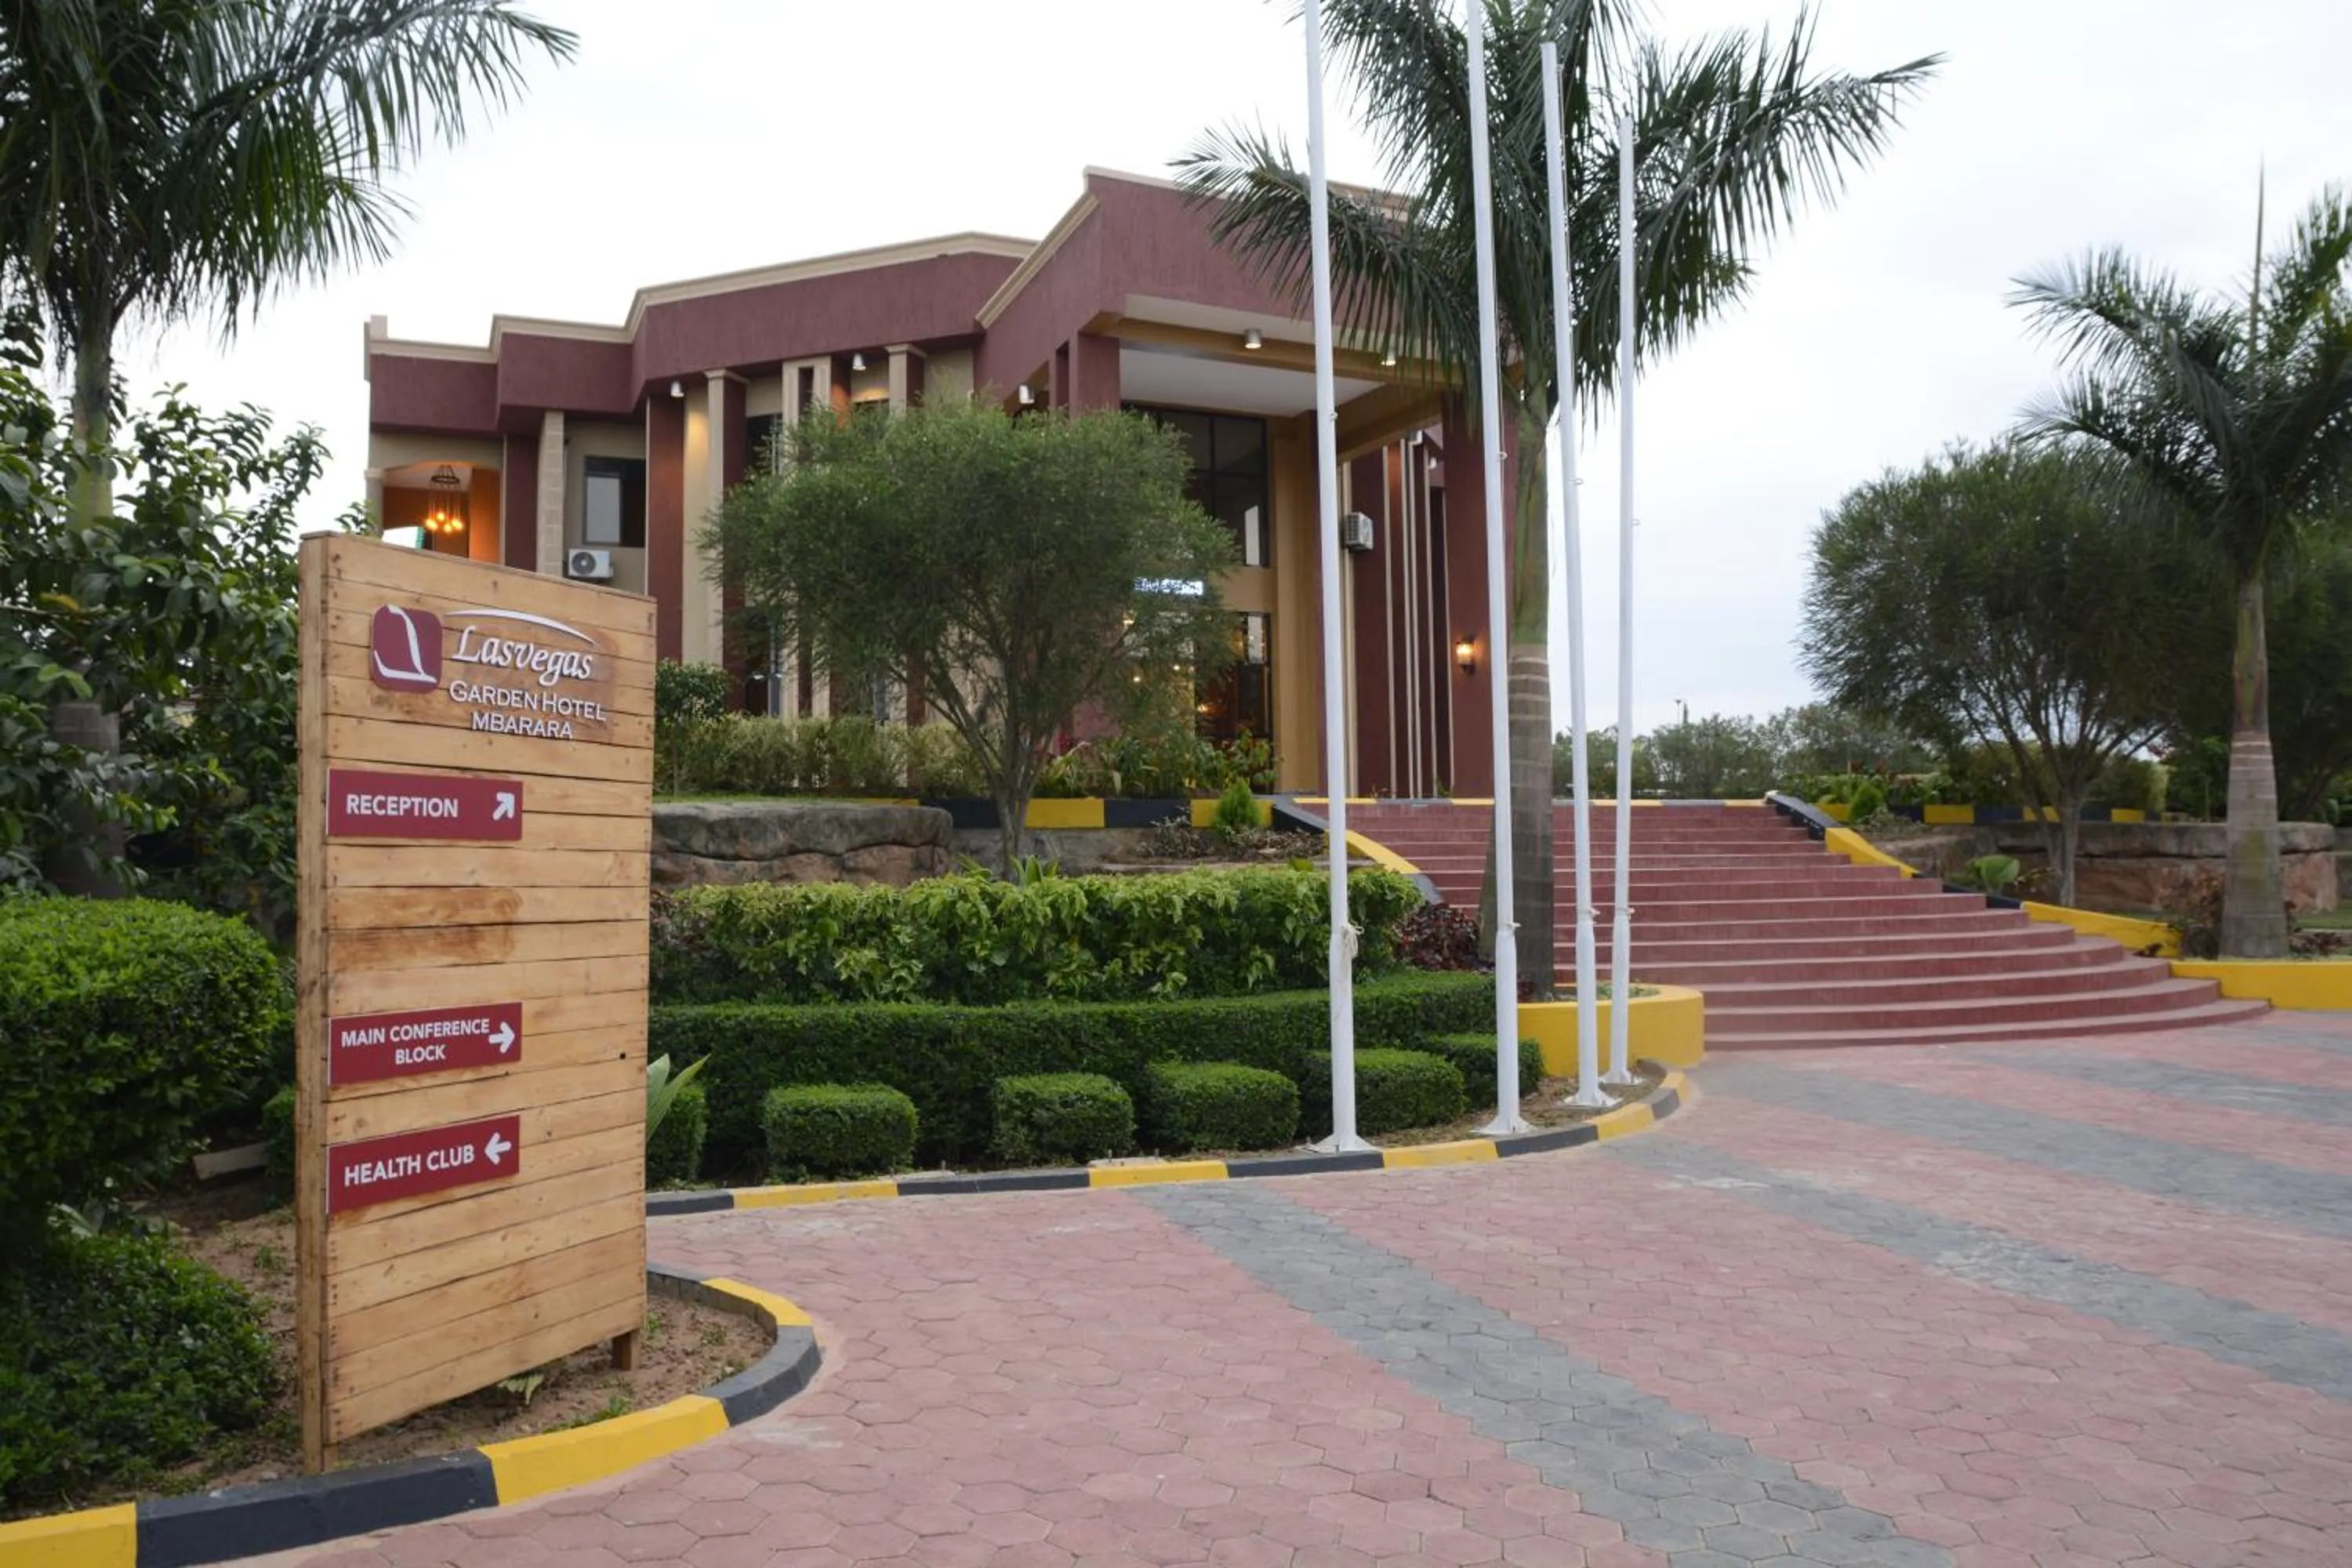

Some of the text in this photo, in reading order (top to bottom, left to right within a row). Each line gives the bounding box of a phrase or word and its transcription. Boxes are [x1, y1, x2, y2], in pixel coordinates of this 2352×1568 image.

[451, 626, 593, 686] Lasvegas
[449, 681, 607, 721] GARDEN HOTEL
[472, 712, 574, 739] MBARARA
[347, 793, 459, 818] RECEPTION
[341, 1018, 490, 1047] MAIN CONFERENCE
[394, 1044, 446, 1065] BLOCK
[344, 1144, 475, 1186] HEALTH CLUB
